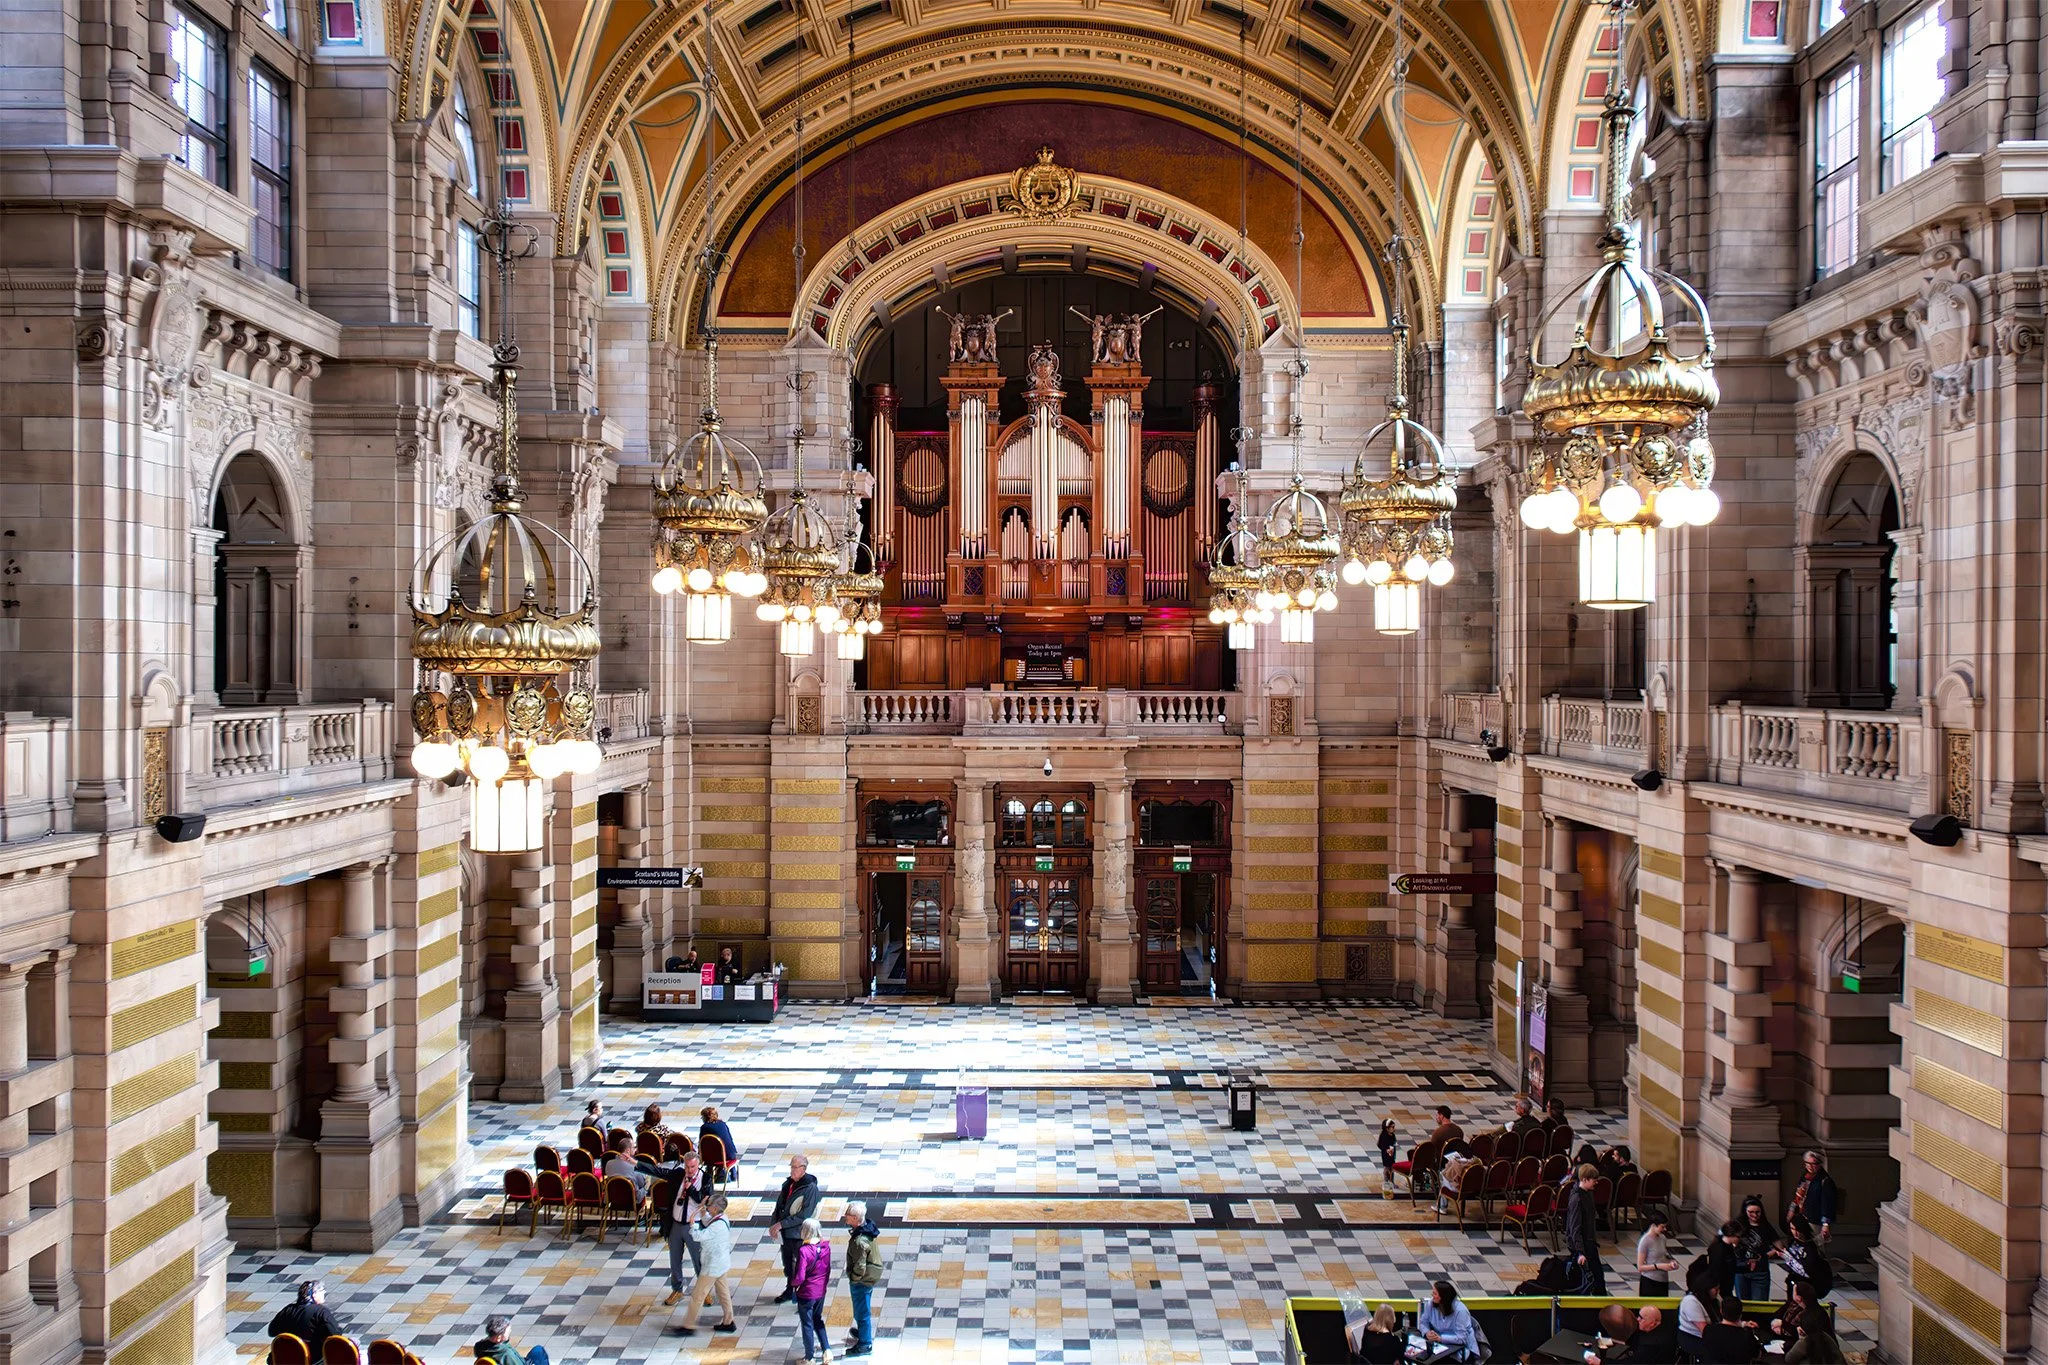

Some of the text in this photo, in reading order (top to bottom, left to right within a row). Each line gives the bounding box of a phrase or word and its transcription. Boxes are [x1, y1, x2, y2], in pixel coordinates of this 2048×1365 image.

[635, 870, 660, 878] Scotland's
[639, 878, 662, 886] Discovery
[647, 976, 682, 985] Reception
